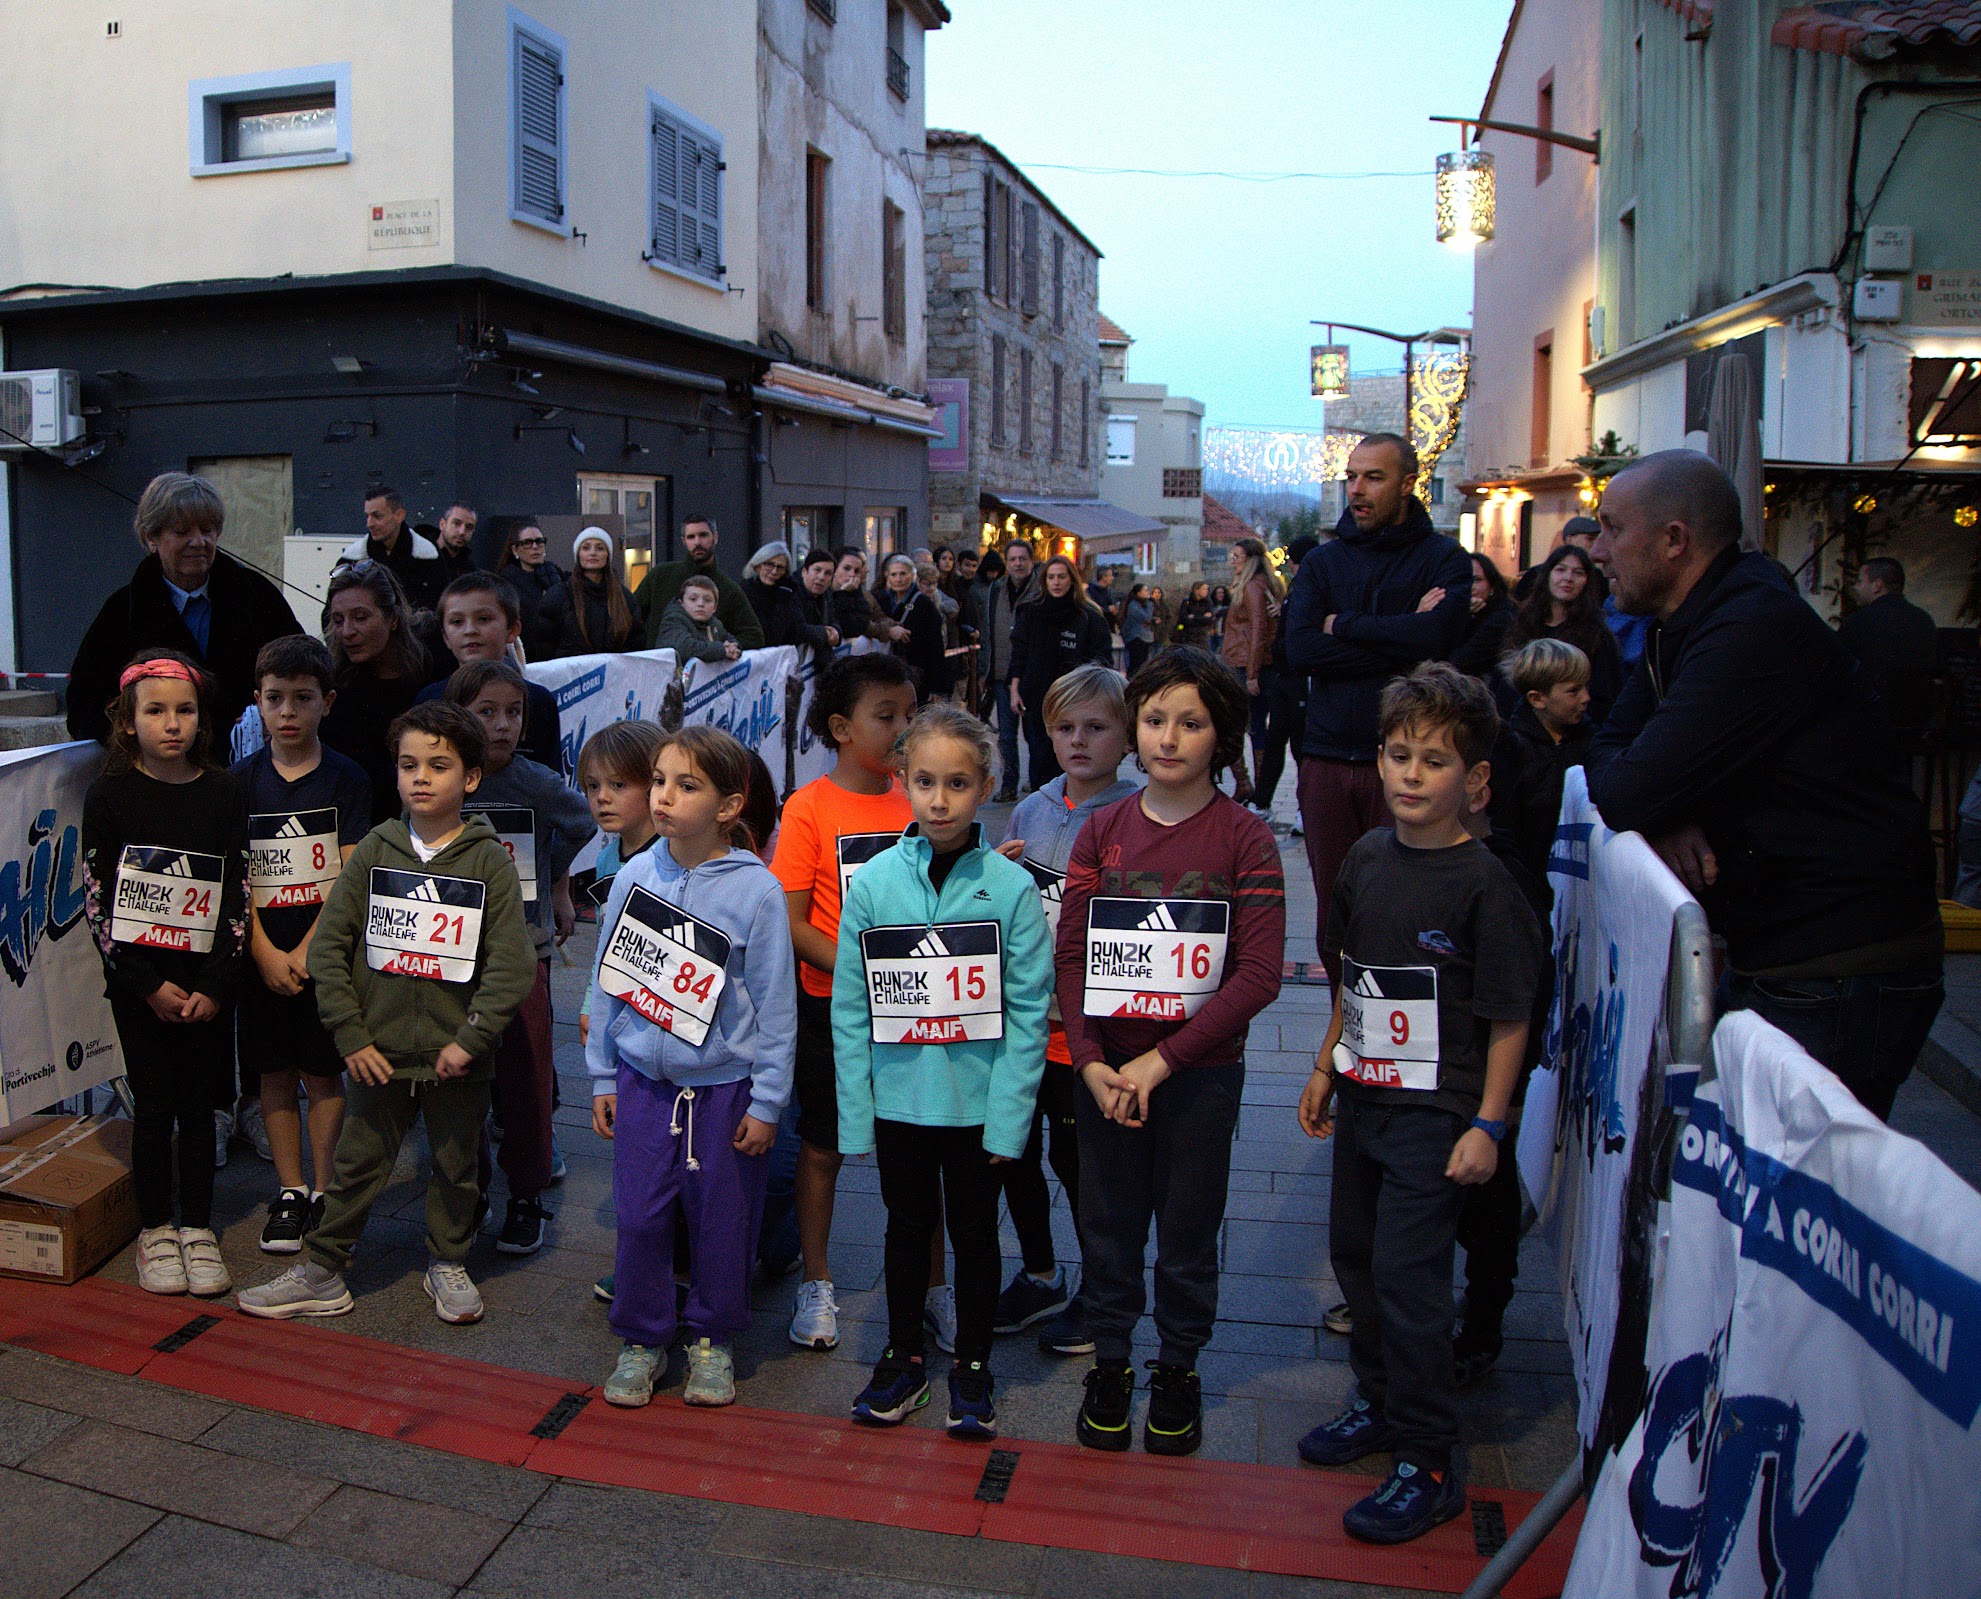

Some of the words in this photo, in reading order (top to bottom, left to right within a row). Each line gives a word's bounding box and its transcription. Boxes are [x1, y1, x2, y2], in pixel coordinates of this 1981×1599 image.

[250, 848, 292, 868] RUN2K
[312, 842, 326, 871] 8
[251, 863, 294, 877] CHALLENGE
[118, 894, 171, 915] CHALLENGE
[119, 879, 174, 902] RUN2K
[181, 887, 212, 918] 24
[276, 887, 319, 904] MAIF
[145, 928, 190, 947] MAIF
[369, 920, 417, 941] CHALLENGE
[371, 905, 419, 928] RUN2K
[429, 912, 465, 946] 21
[393, 955, 440, 975] MAIF
[612, 945, 663, 981] CHALLENGE
[616, 925, 669, 969] RUN2K
[673, 961, 716, 1004] 84
[1091, 941, 1153, 965] RUN2K
[1171, 942, 1211, 979] 16
[1091, 957, 1153, 978] CHALLENGE
[872, 971, 928, 993] RUN2K
[946, 965, 986, 1001] 15
[874, 986, 931, 1005] CHALLENGE
[631, 988, 674, 1024] MAIF
[1126, 996, 1183, 1017] MAIF
[911, 1020, 962, 1040] MAIF
[1389, 1010, 1410, 1046] 9
[85, 1038, 101, 1051] ASPV
[5, 1062, 56, 1092] Portivechju
[1868, 1262, 1954, 1374] CORRI
